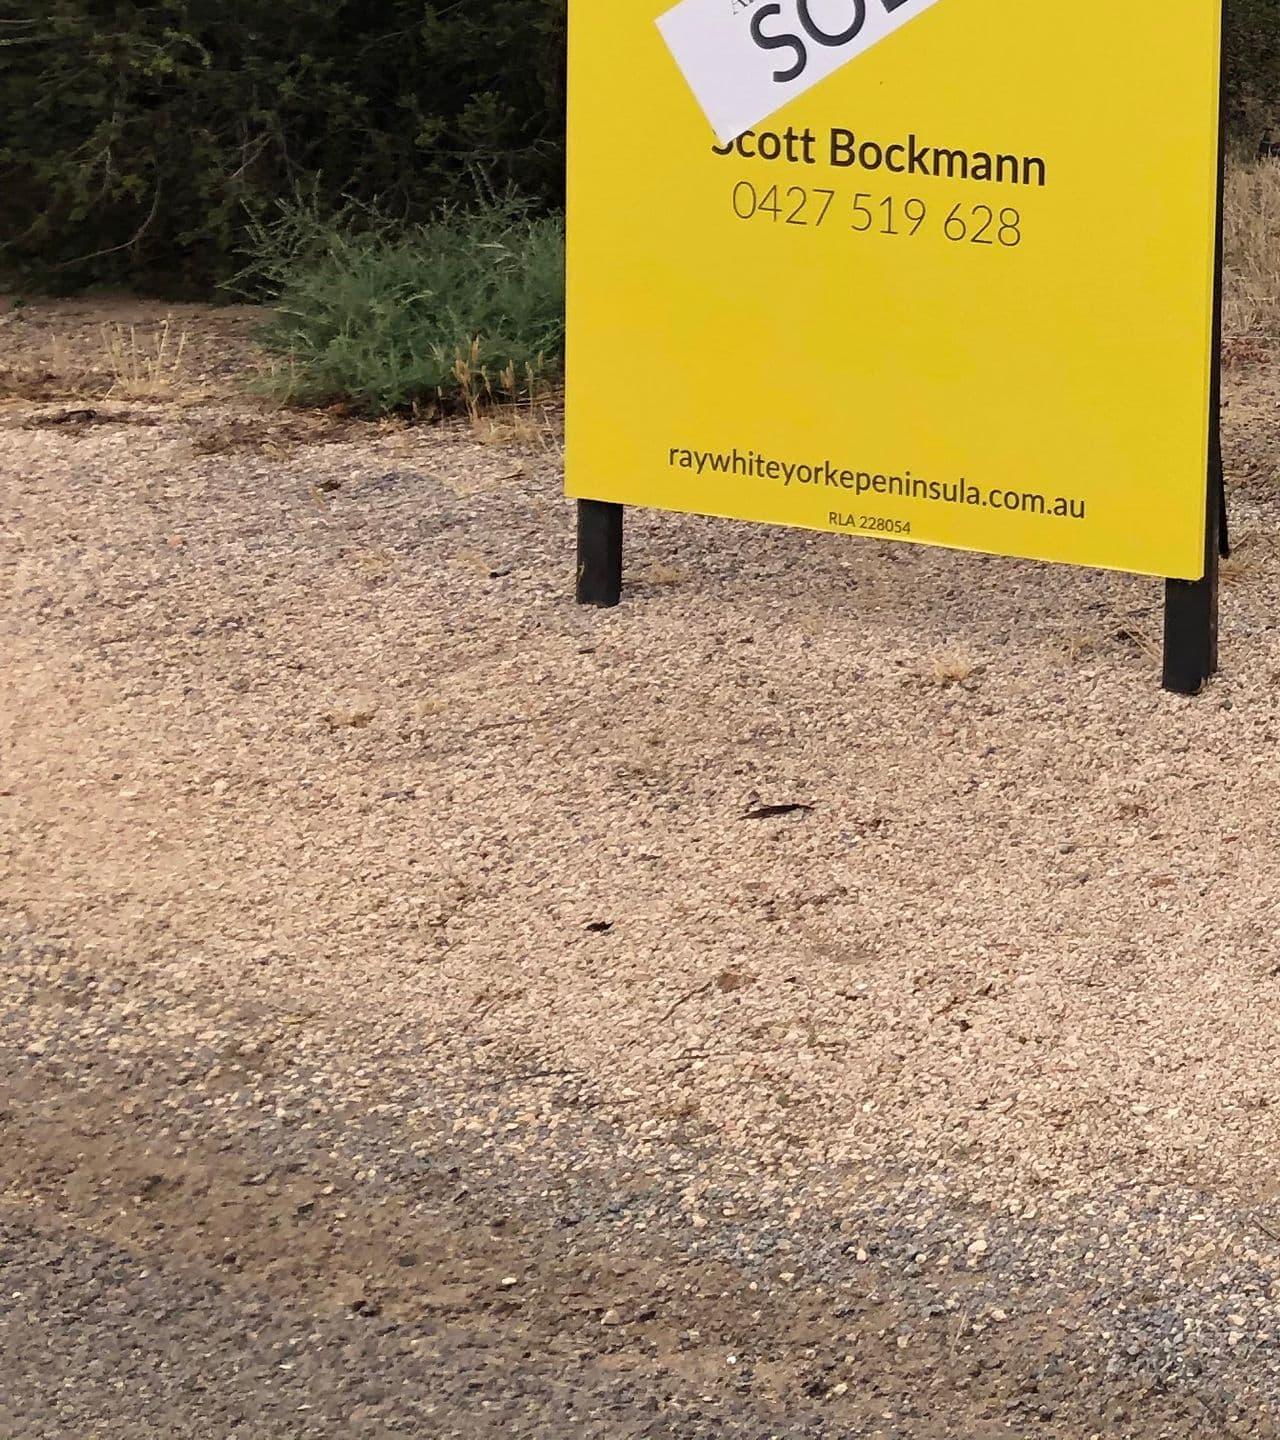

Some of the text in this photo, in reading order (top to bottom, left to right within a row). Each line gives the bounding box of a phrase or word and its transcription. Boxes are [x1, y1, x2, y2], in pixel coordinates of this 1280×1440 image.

[830, 127, 1046, 187] Bockmann
[732, 180, 1021, 247] 0427 519 628
[669, 448, 1086, 519] raywhiteyorkepeninsula.com.au
[828, 511, 911, 535] RLA 228054
